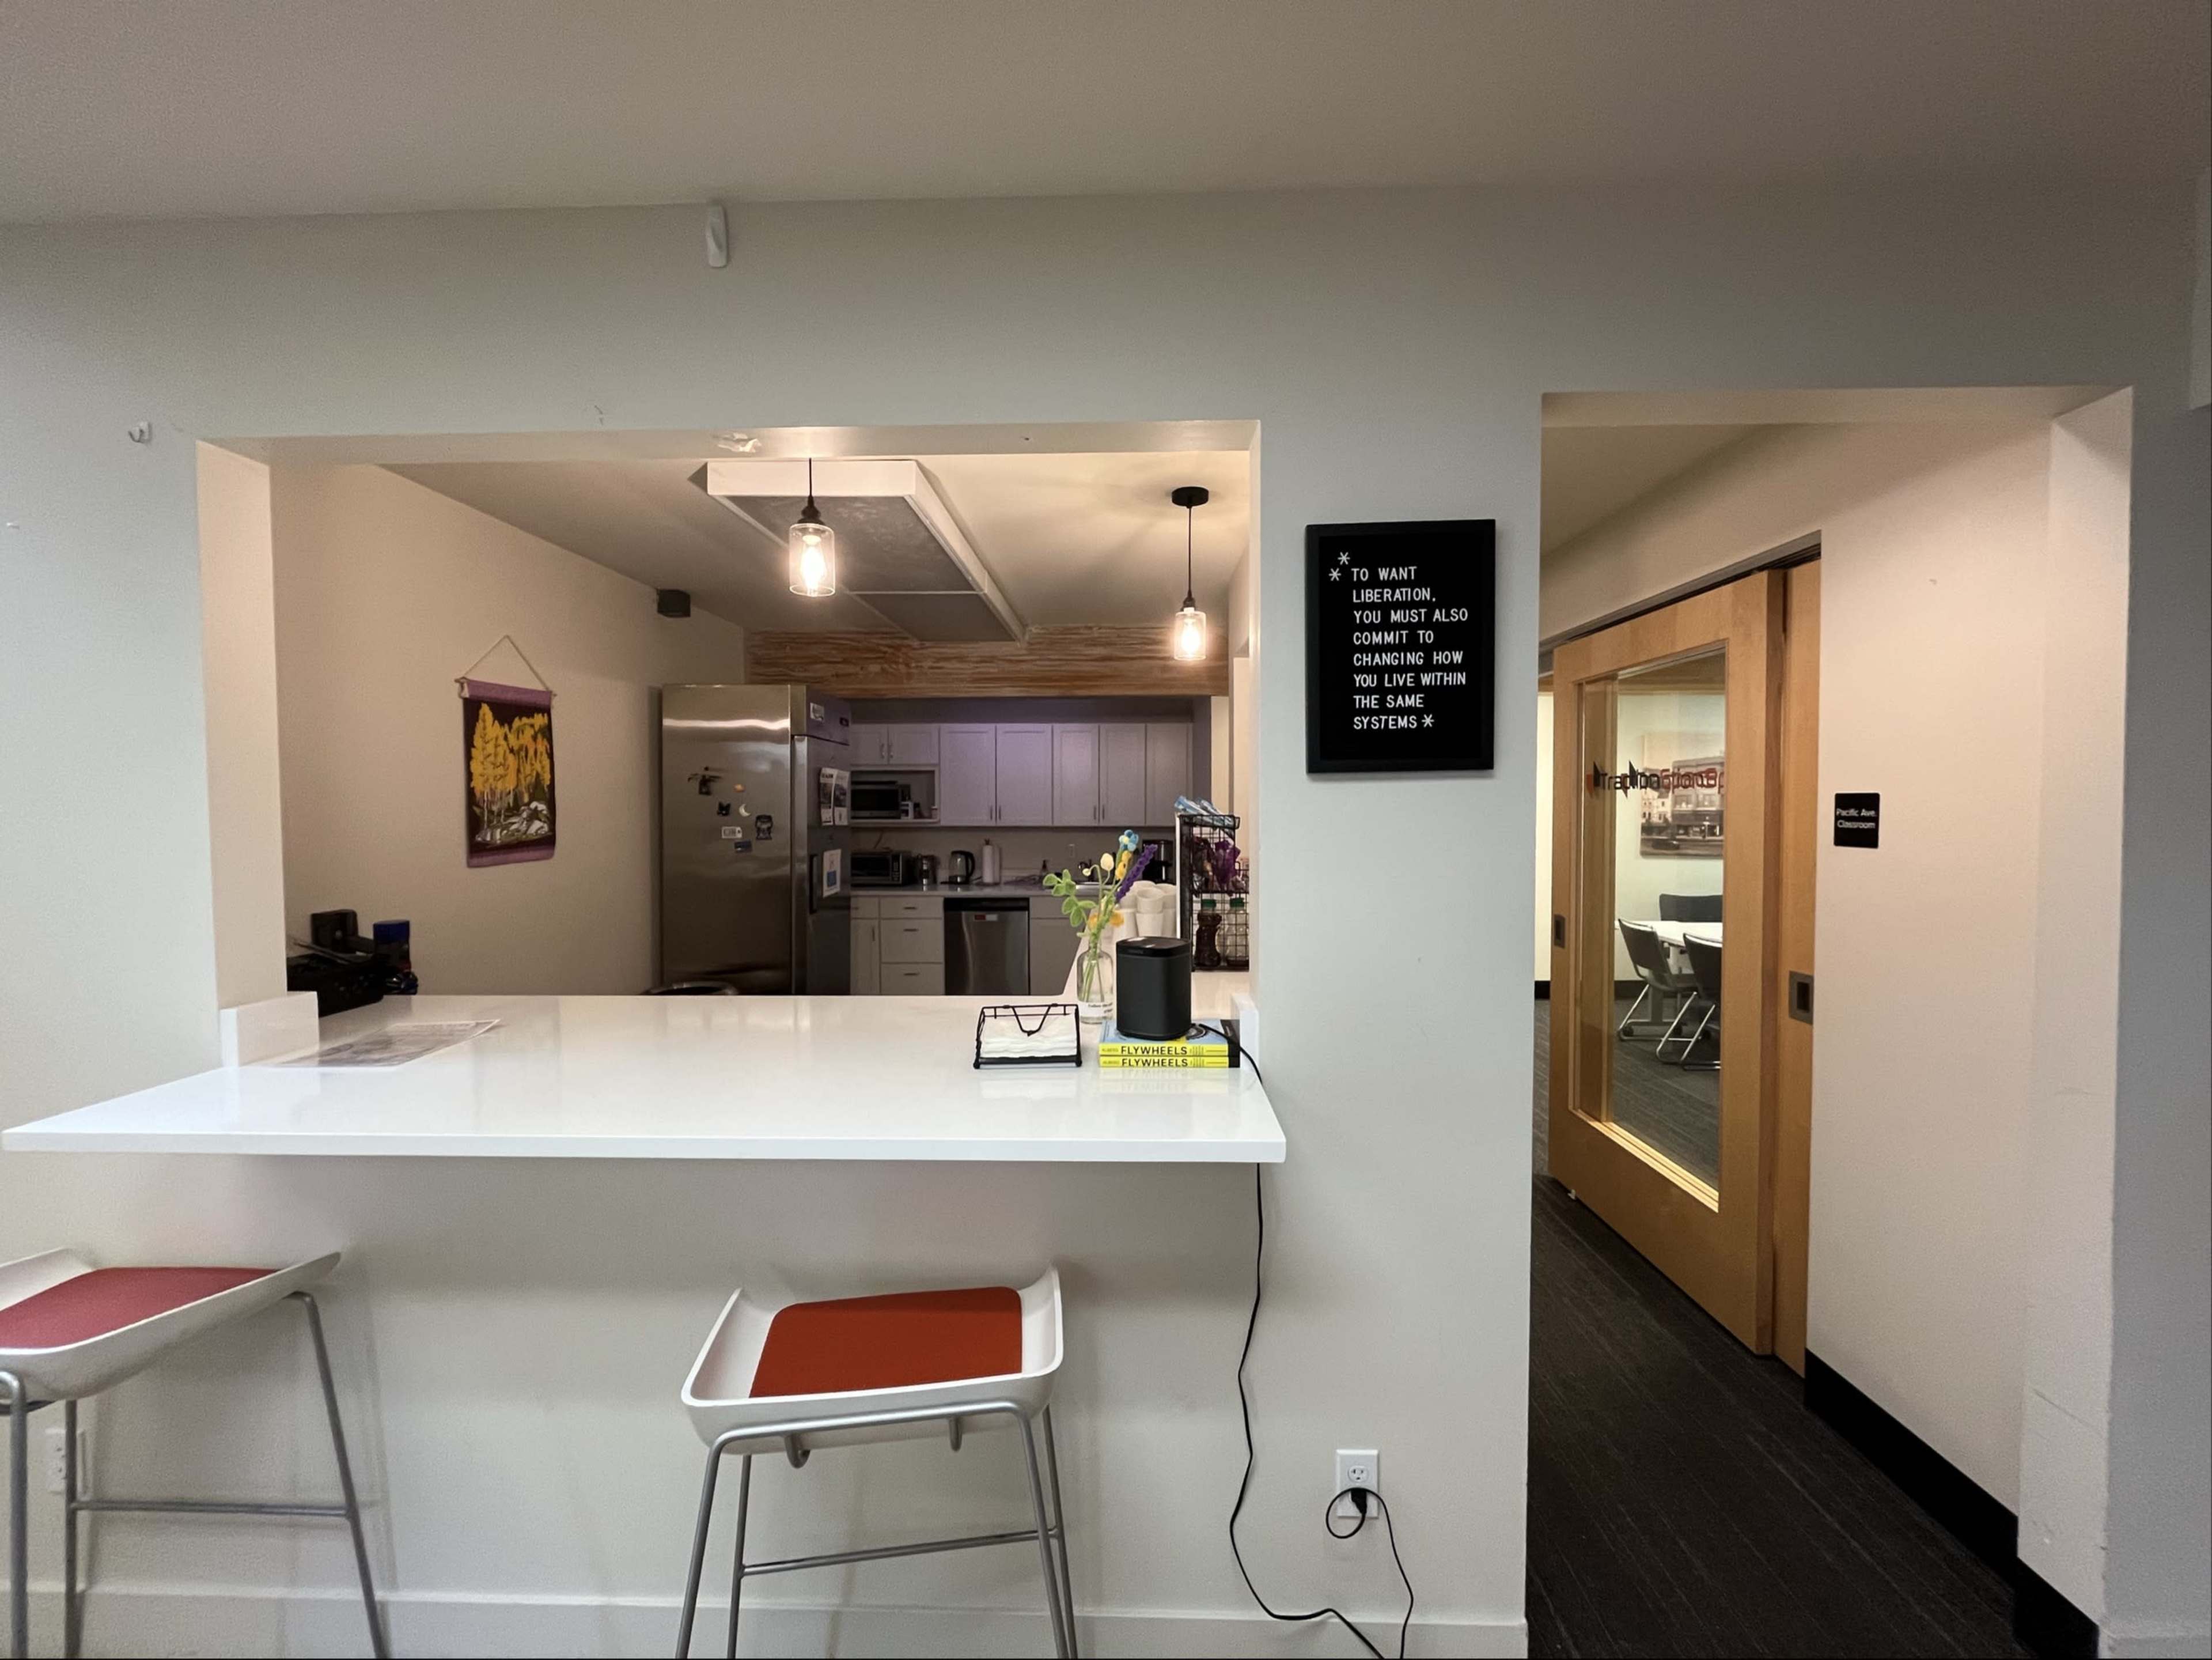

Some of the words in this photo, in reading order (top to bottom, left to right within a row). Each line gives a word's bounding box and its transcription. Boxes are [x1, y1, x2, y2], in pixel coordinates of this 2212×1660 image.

[1351, 569, 1368, 581] TO
[1378, 566, 1416, 580] WANT
[1354, 611, 1380, 623] YOU
[1391, 609, 1427, 622] MUST
[1433, 608, 1468, 622] ALSO
[1354, 631, 1408, 645] COMMIT
[1418, 630, 1433, 643] TO
[1354, 652, 1423, 665] CHANGING
[1434, 651, 1463, 664] HOW
[1354, 674, 1376, 687] YOU
[1385, 674, 1415, 686] LIVE
[1421, 672, 1465, 686] WITHIN
[1354, 695, 1379, 708] THE
[1387, 694, 1424, 708] SAME
[1354, 716, 1416, 729] SYSTEMS
[1836, 808, 1859, 816] Pacific
[1837, 819, 1876, 829] Classroom
[1121, 1046, 1187, 1054] FLYWHEELS
[1122, 1058, 1188, 1067] FLYWHEELS
